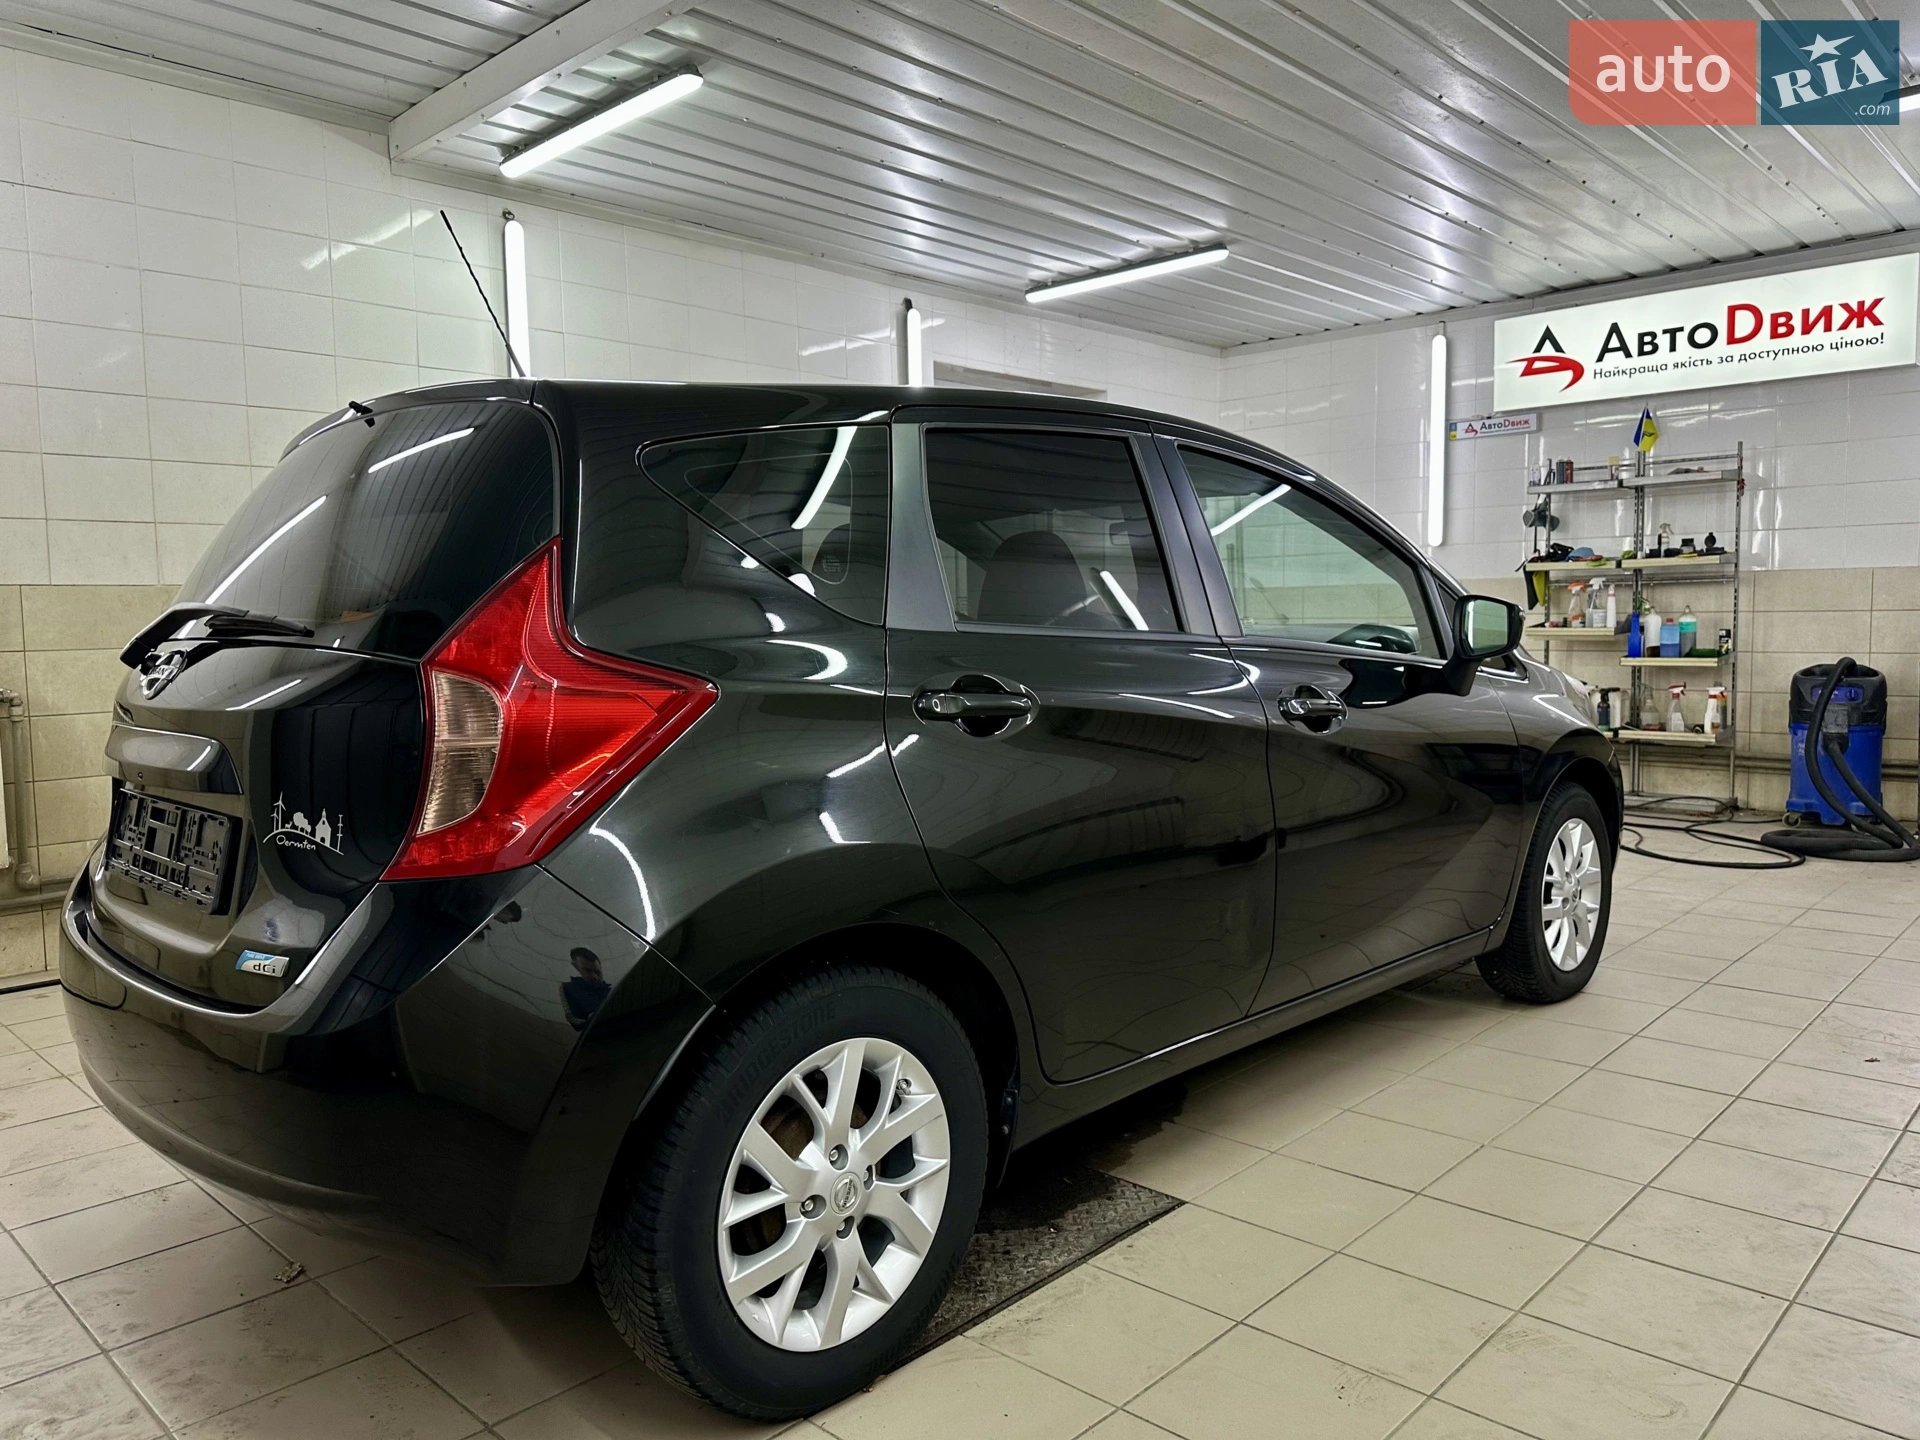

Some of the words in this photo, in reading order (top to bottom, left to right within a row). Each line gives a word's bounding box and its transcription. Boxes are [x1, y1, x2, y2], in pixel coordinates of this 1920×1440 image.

[1593, 363, 1668, 380] Найкраща
[1672, 356, 1713, 370] якість
[1717, 356, 1734, 364] за
[1738, 344, 1825, 363] доступною
[1829, 332, 1885, 352] ціною!
[253, 962, 276, 974] dCi
